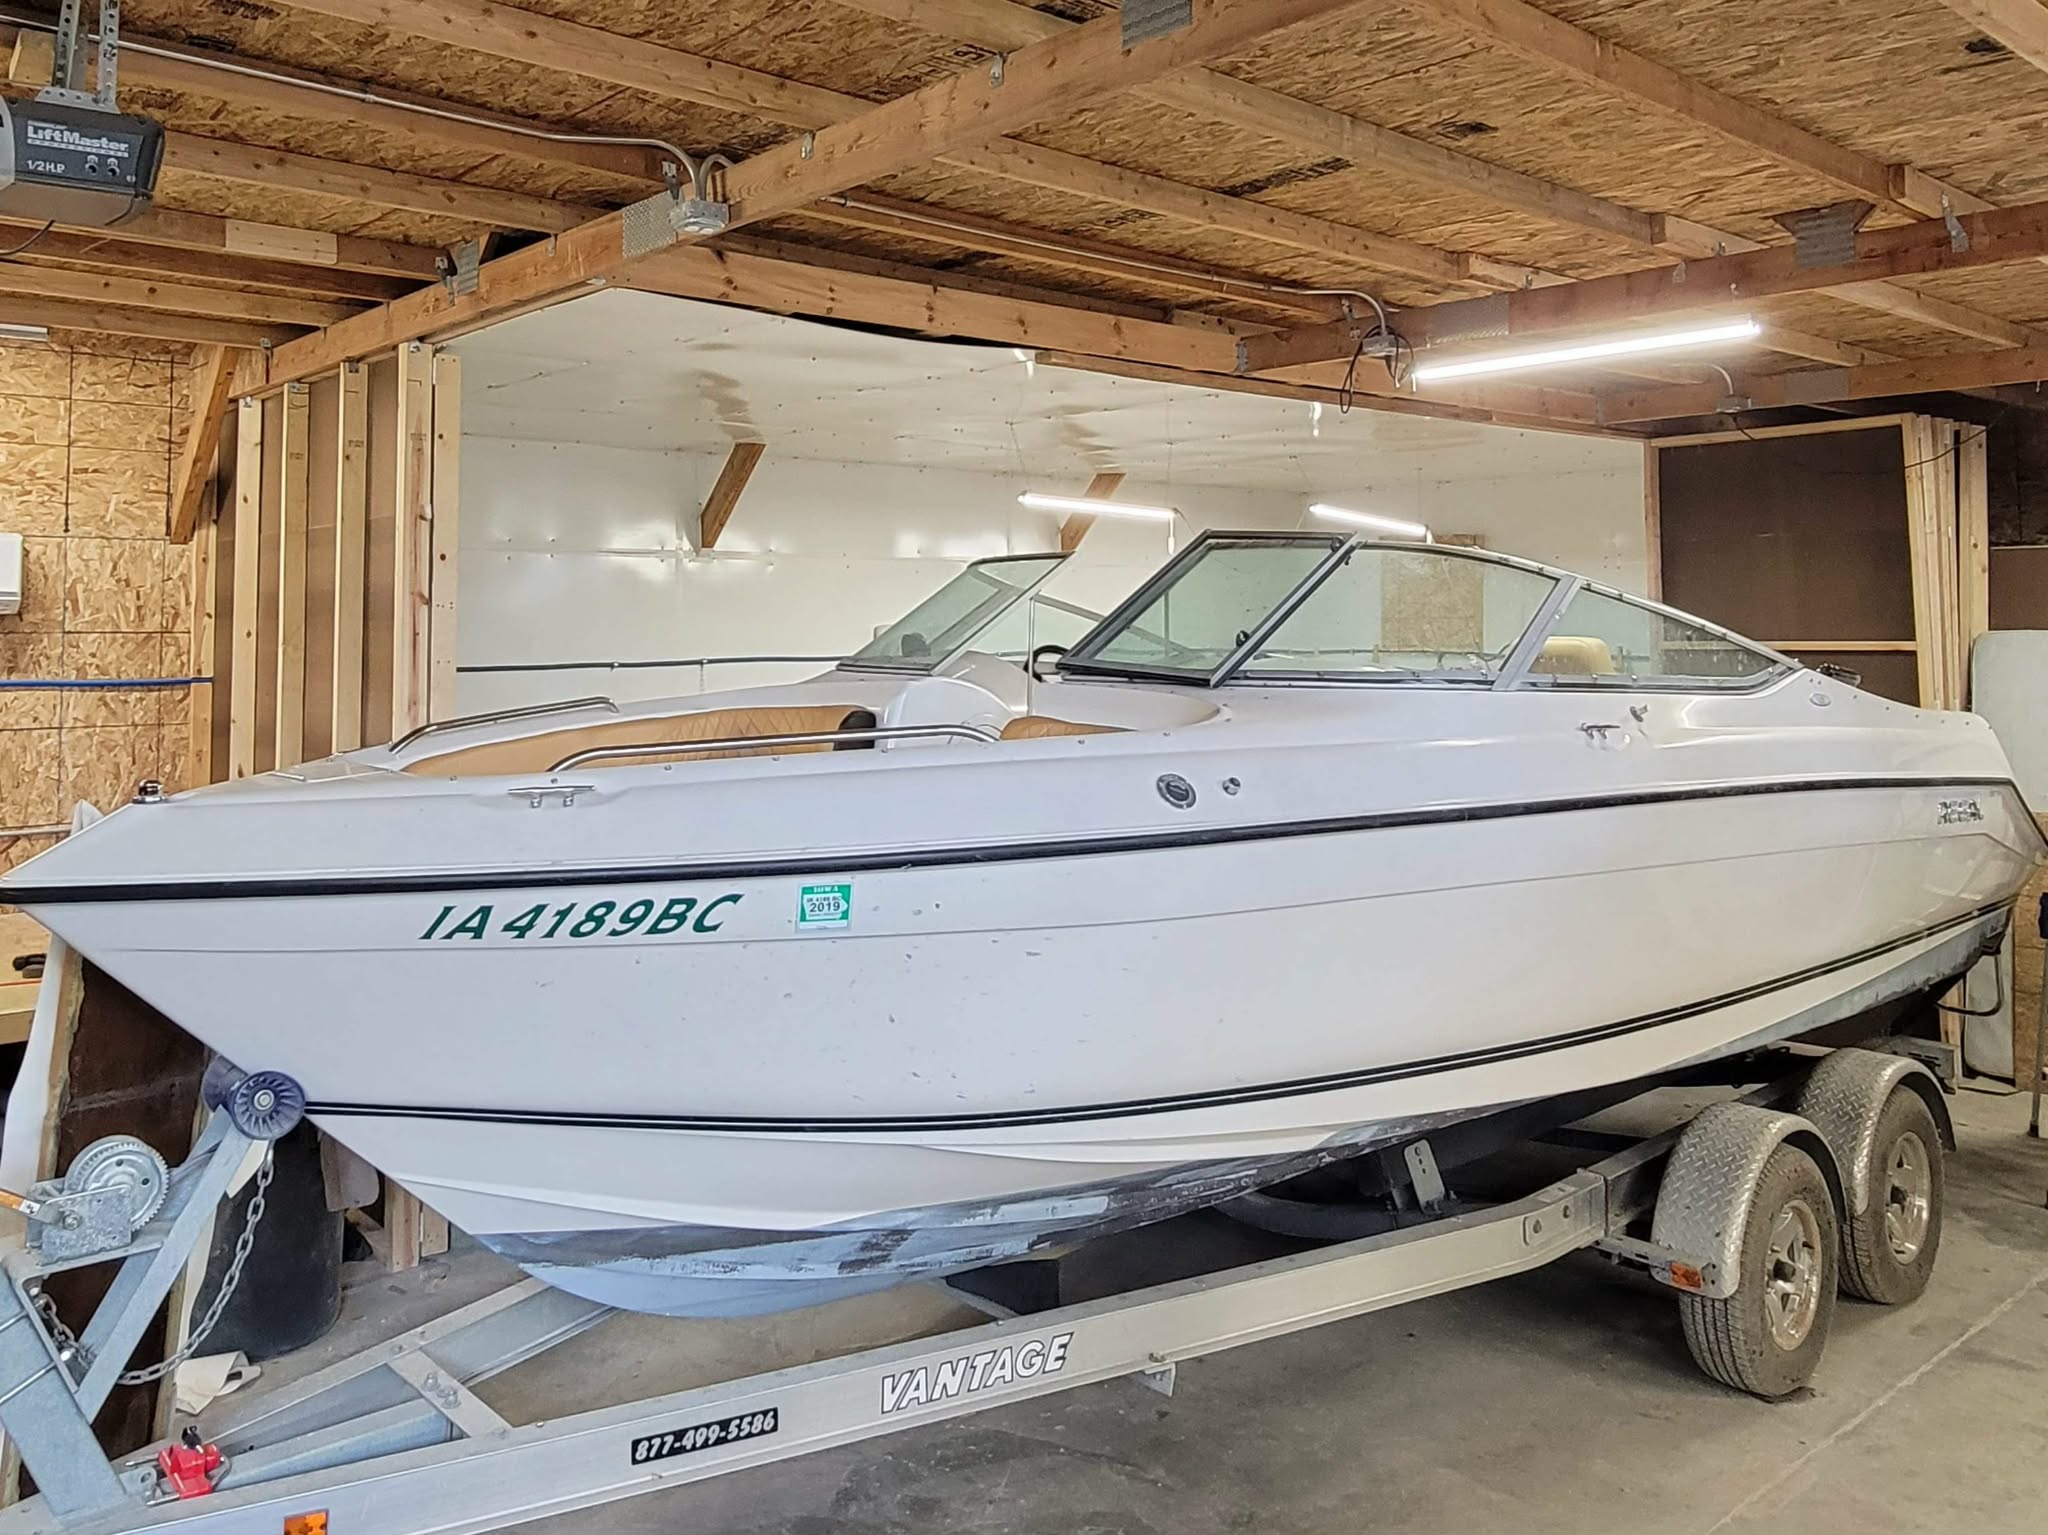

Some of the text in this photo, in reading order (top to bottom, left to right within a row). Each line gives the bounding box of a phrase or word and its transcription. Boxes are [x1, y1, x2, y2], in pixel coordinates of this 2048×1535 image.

[418, 893, 745, 940] IA 4189BC
[810, 902, 840, 912] 2019
[881, 1331, 1075, 1414] VANTAGE
[634, 1410, 775, 1461] 877-499-5586
